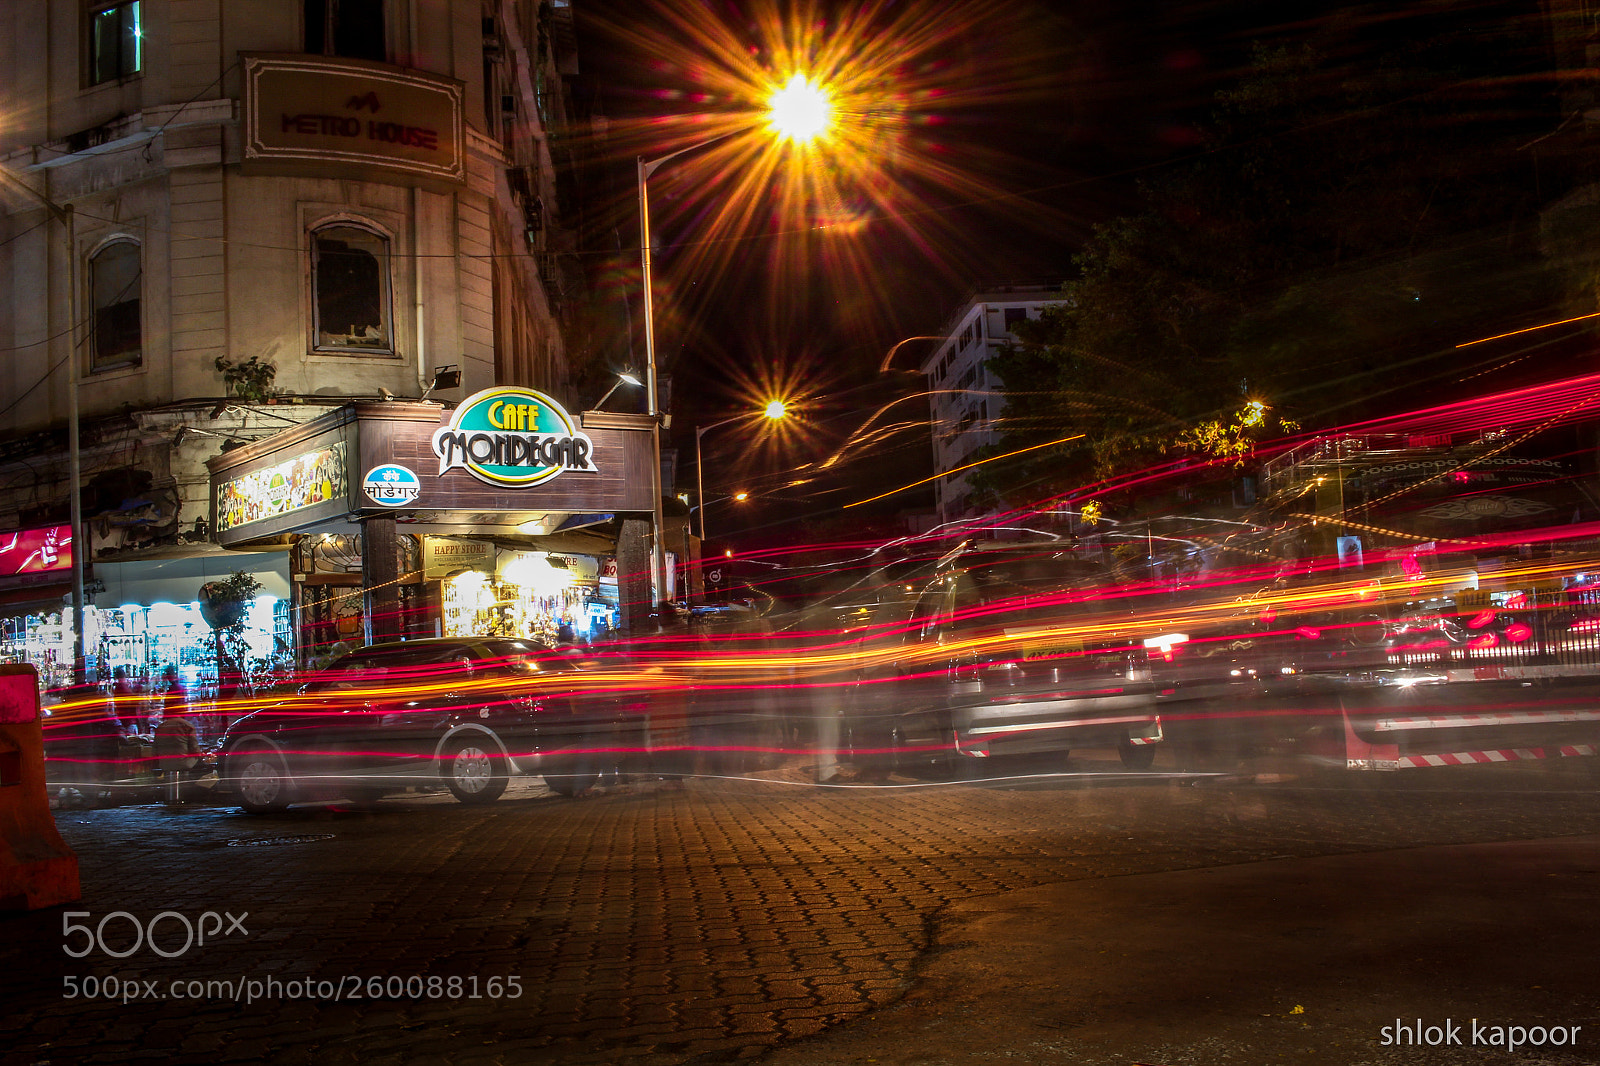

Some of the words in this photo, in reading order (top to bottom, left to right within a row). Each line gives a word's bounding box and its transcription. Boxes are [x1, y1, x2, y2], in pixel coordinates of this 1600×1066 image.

[282, 113, 361, 137] METRO
[368, 120, 438, 150] HOUSE
[487, 401, 540, 431] CAFE
[439, 430, 589, 469] MONDEGAR
[363, 482, 419, 498] मोंडेगर
[434, 545, 460, 555] HAPPY
[461, 544, 486, 554] STORE
